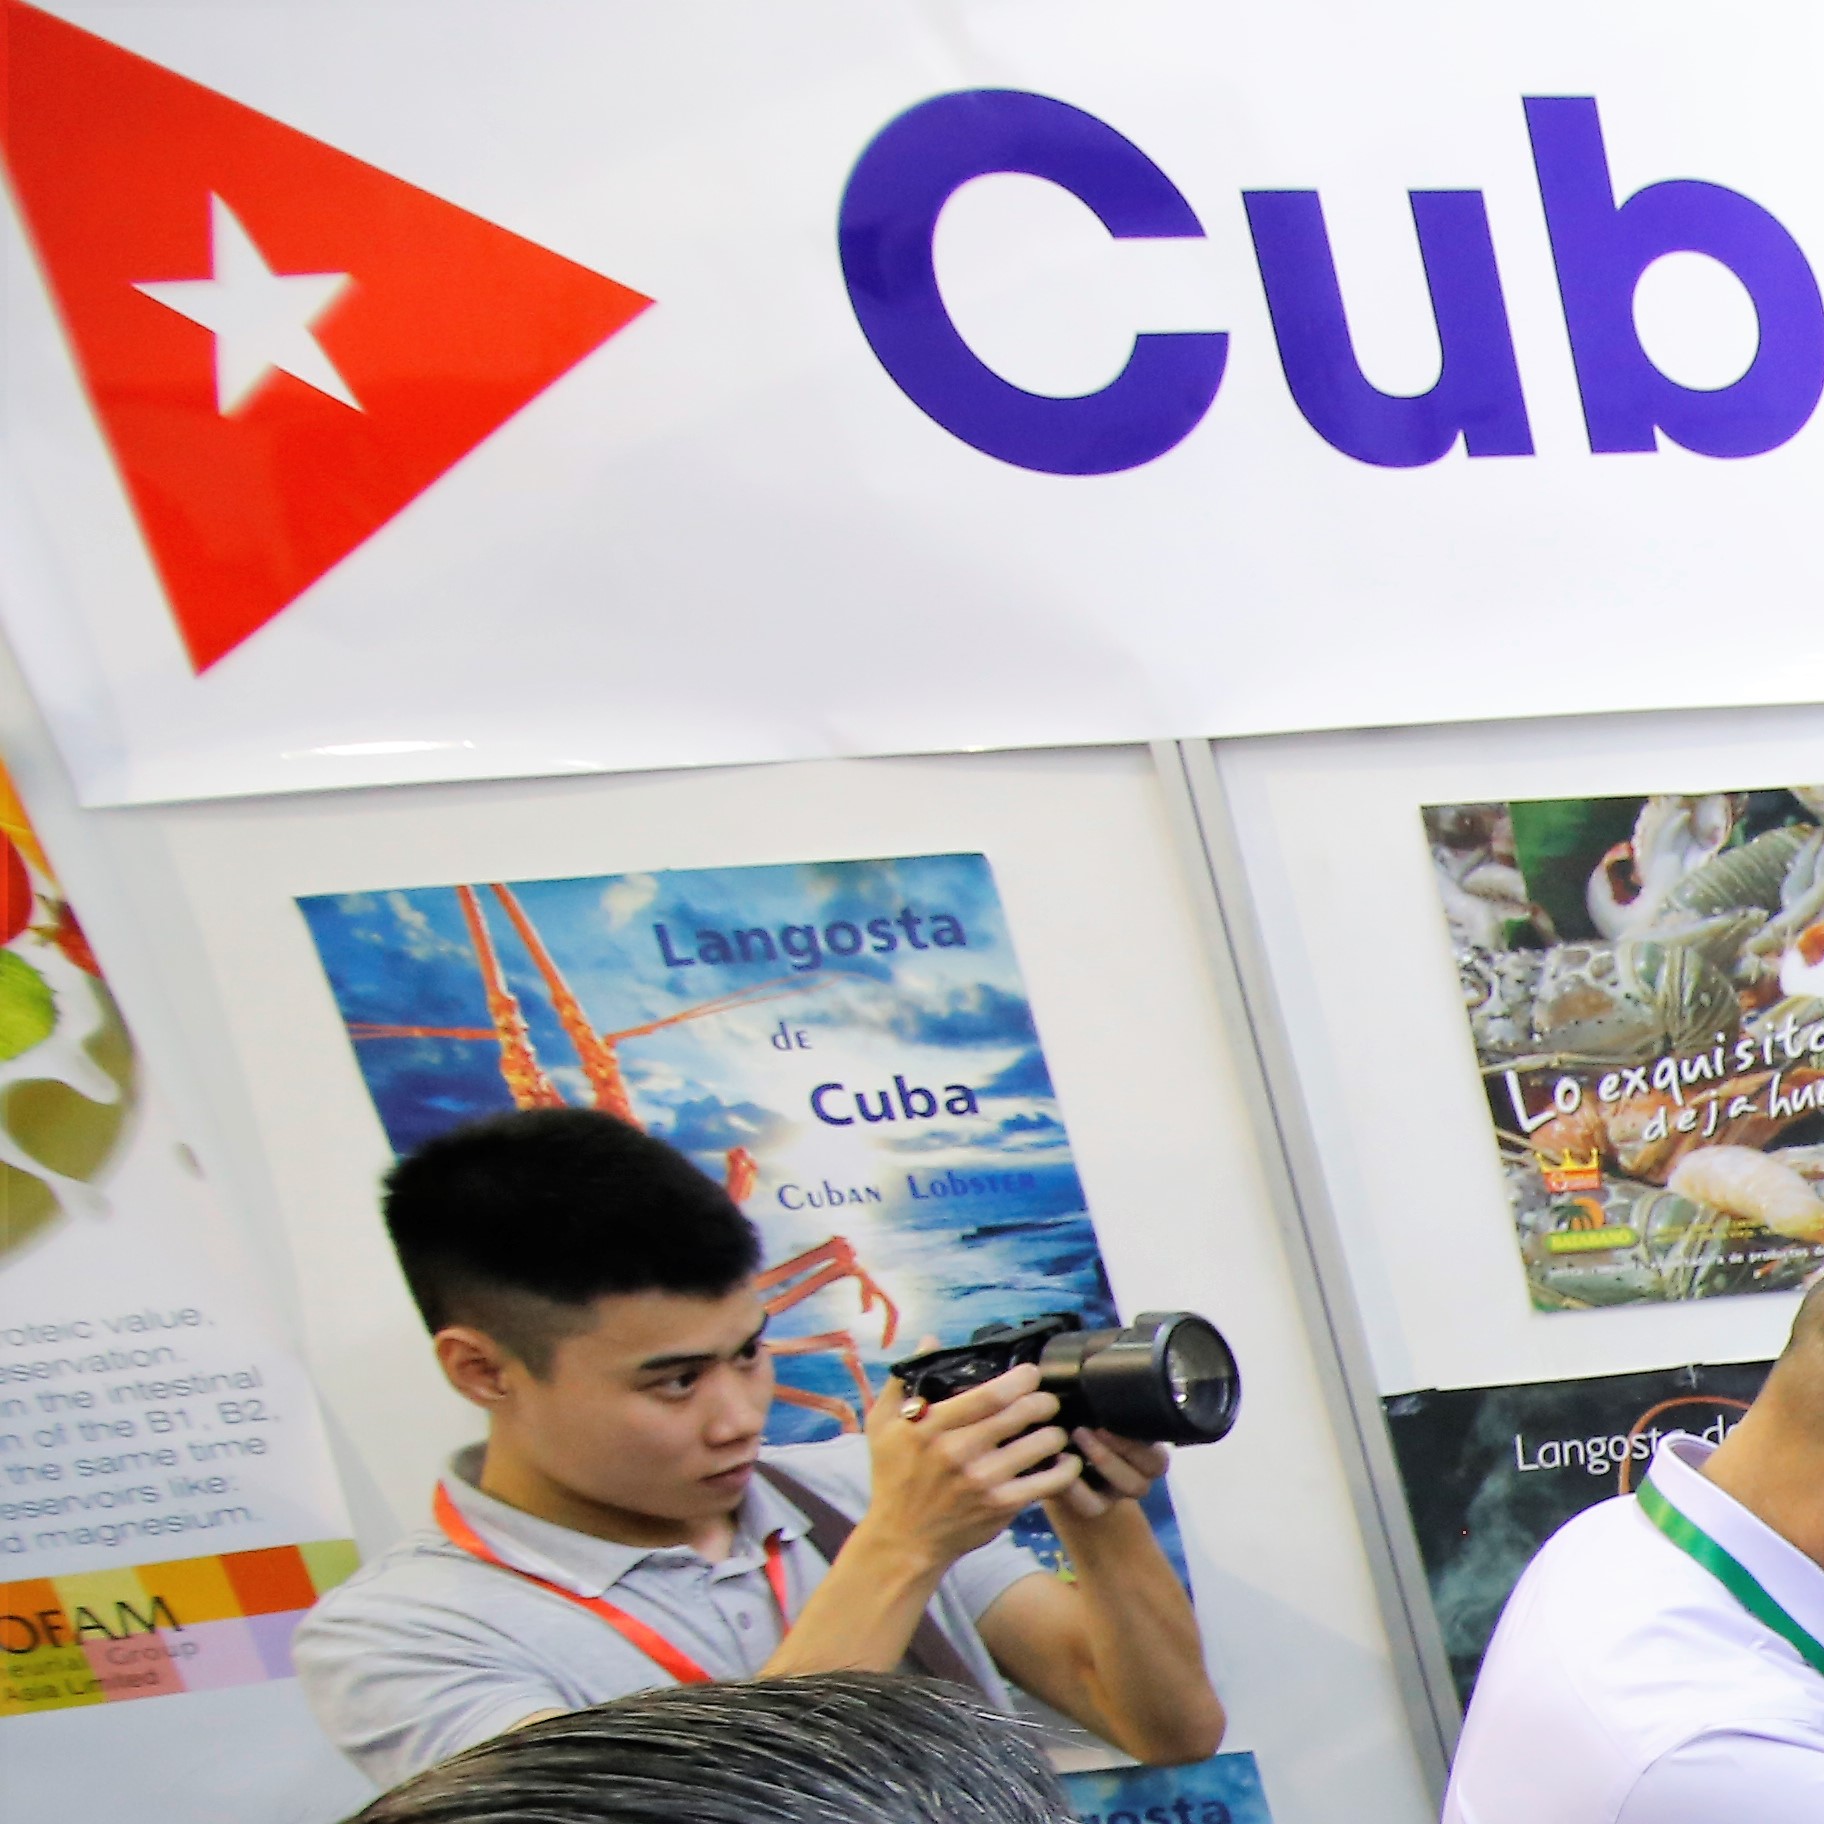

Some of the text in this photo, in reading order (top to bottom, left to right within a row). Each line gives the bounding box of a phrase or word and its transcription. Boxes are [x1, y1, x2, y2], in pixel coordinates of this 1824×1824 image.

[653, 906, 968, 971] Langosta
[809, 1075, 980, 1128] Cuba
[1503, 1068, 1583, 1134] Lo
[1643, 1090, 1759, 1144] deja
[106, 1365, 263, 1405] intestinal
[75, 1448, 177, 1477] same
[187, 1437, 268, 1462] time
